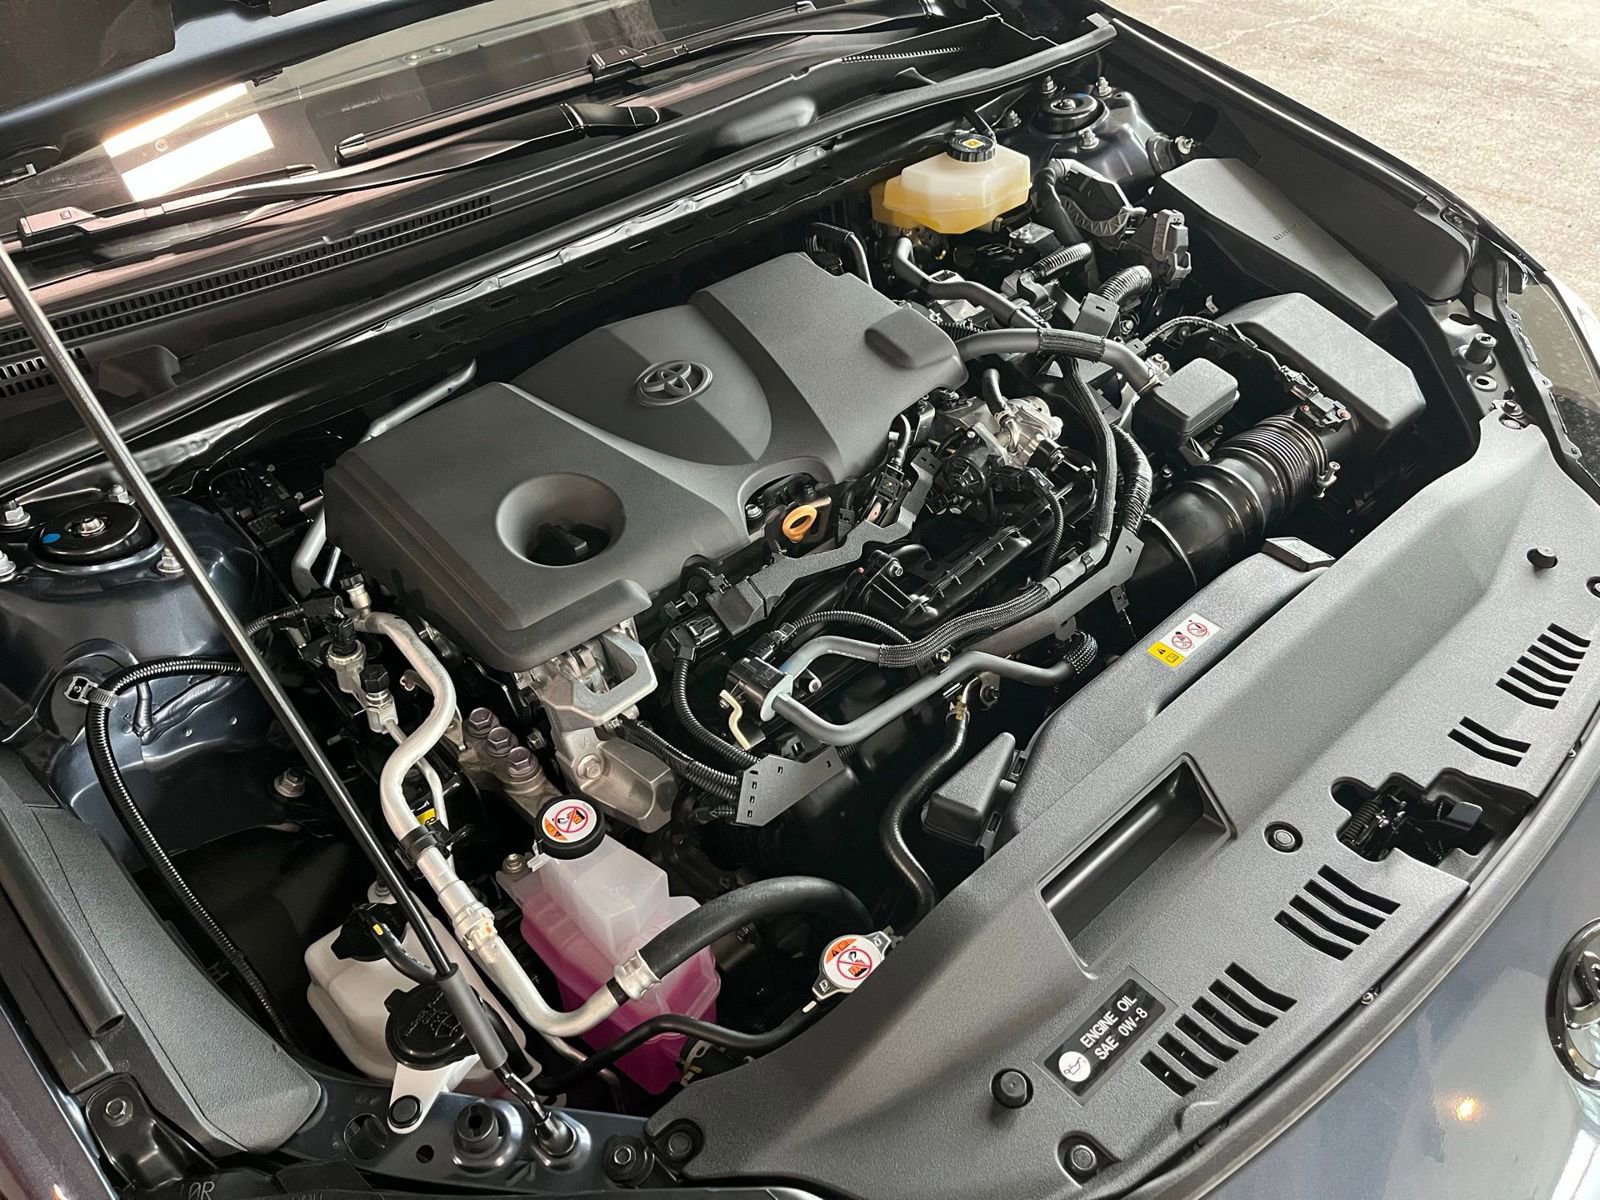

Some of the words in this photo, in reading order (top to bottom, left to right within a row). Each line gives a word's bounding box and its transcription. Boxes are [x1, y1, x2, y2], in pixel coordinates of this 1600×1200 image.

[1079, 1010, 1119, 1048] ENGINE
[1116, 995, 1138, 1012] OIL
[1094, 1035, 1120, 1060] SAE
[1117, 1007, 1148, 1037] 0W-8
